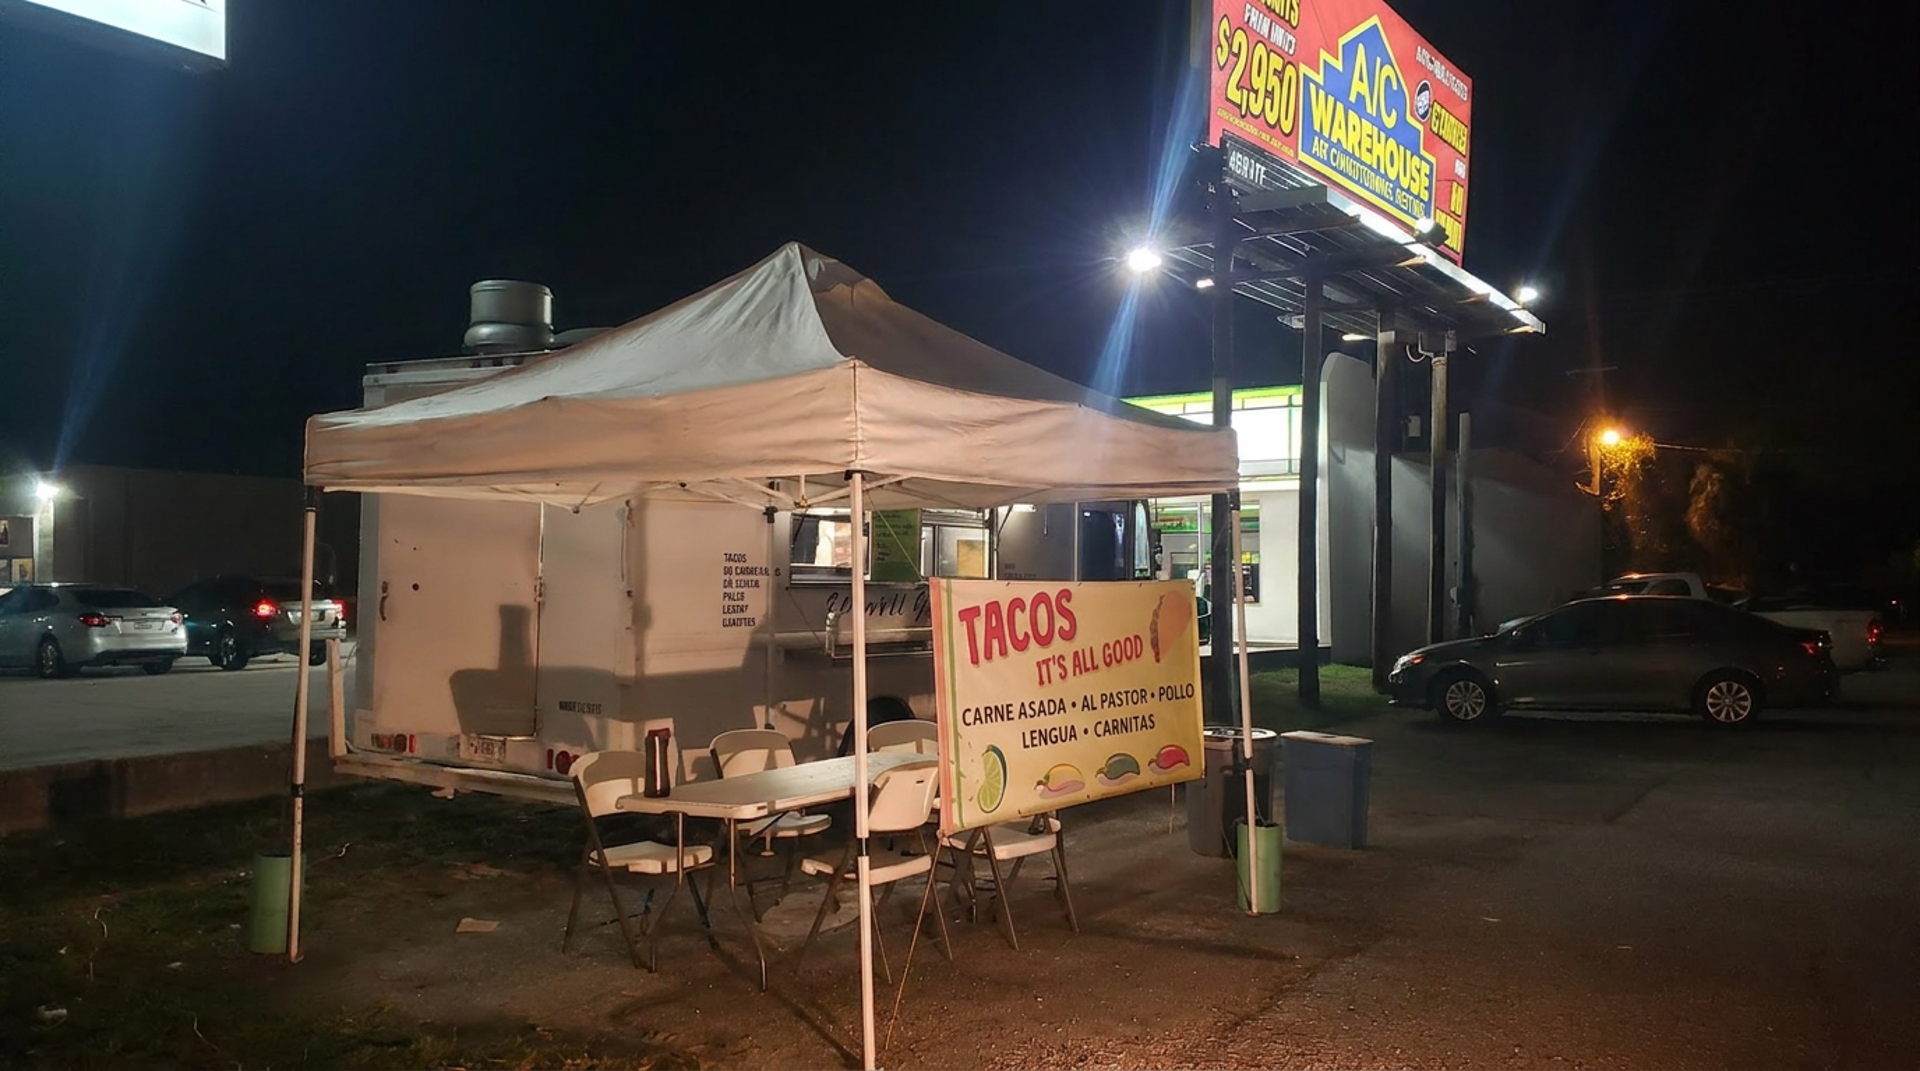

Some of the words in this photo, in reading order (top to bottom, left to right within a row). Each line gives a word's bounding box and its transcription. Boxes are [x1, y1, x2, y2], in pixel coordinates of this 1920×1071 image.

[1216, 14, 1298, 138] $2,950
[1348, 42, 1399, 130] A/C
[1309, 81, 1431, 203] WAREHOUSE
[958, 588, 1077, 666] TACOS
[1036, 653, 1068, 686] IT'S
[1072, 645, 1099, 677] ALL
[1103, 634, 1144, 667] GOOD
[962, 703, 1014, 727] CARNE
[1018, 697, 1067, 720] ASADA
[1081, 694, 1098, 712] AL
[1100, 688, 1148, 710] PASTOR
[1158, 683, 1195, 703] POLLO
[1022, 724, 1078, 749] LENGUA
[1093, 713, 1156, 738] CARNITAS
